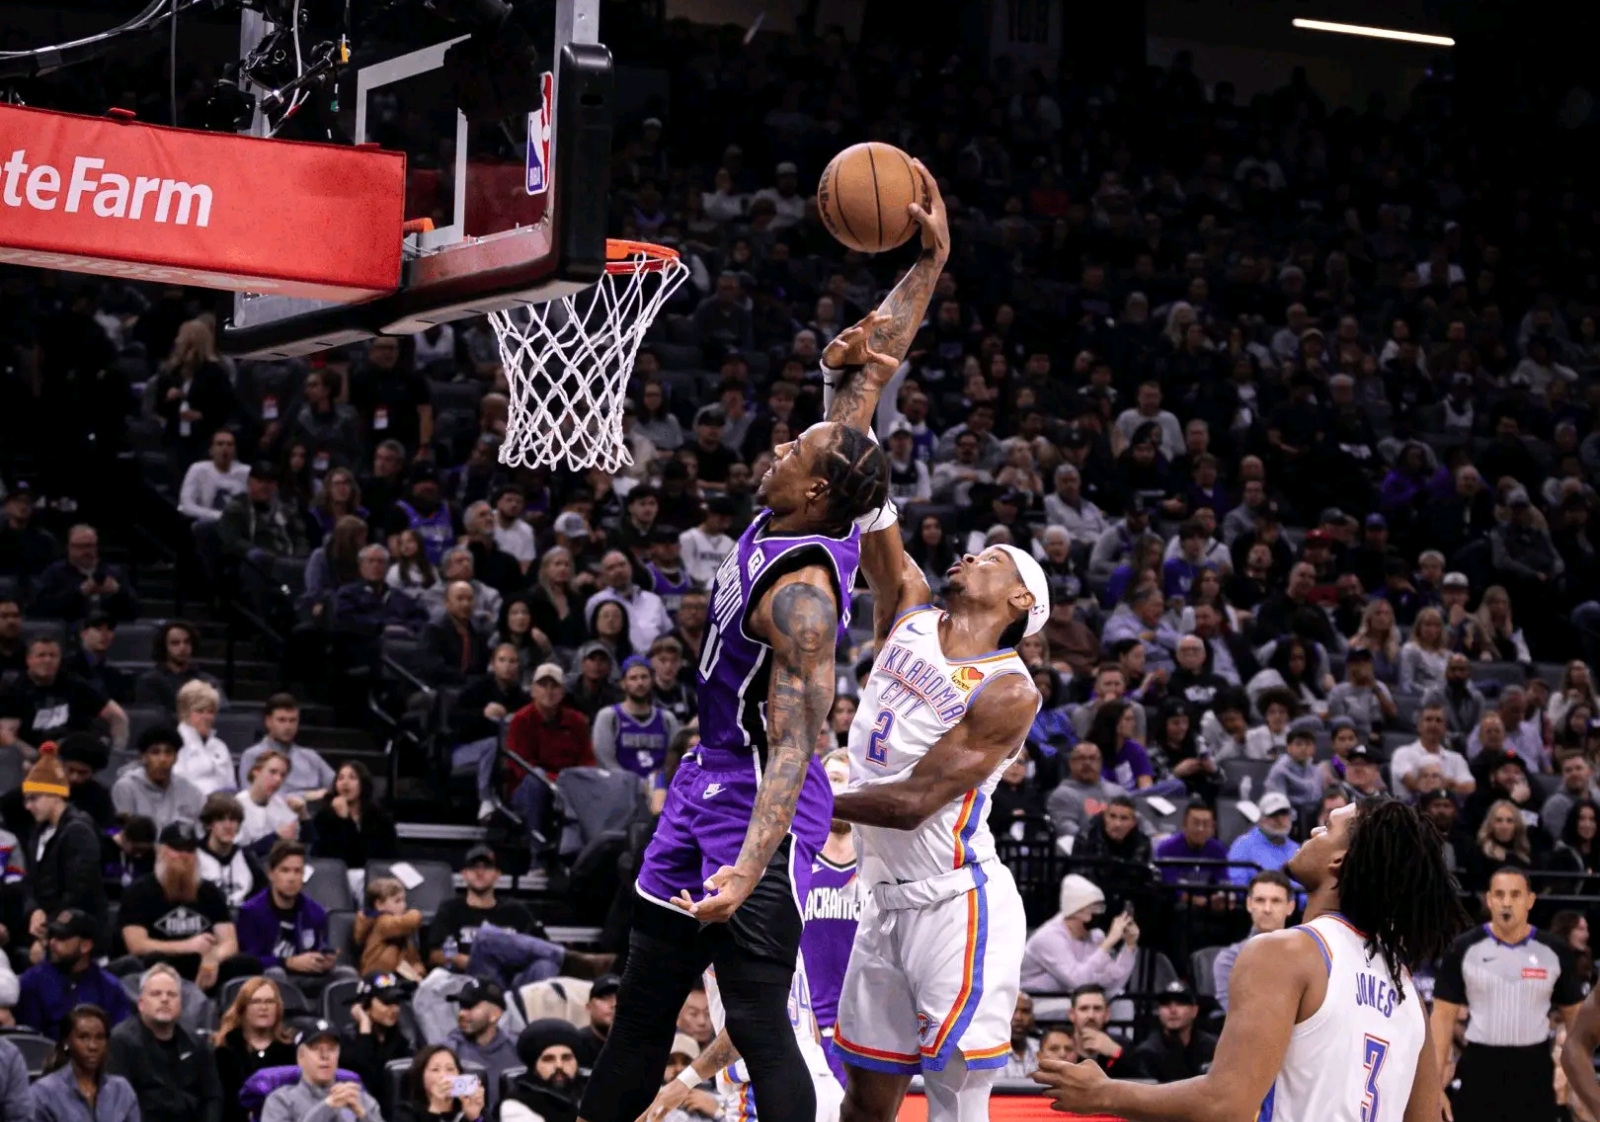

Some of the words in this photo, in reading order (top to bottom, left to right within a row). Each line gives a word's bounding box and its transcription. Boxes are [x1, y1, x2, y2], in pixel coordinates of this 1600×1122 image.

[64, 155, 213, 227] Farm
[879, 680, 926, 719] CITY
[866, 707, 896, 767] 2
[1355, 972, 1397, 1018] JONES
[1360, 1032, 1390, 1122] 3
